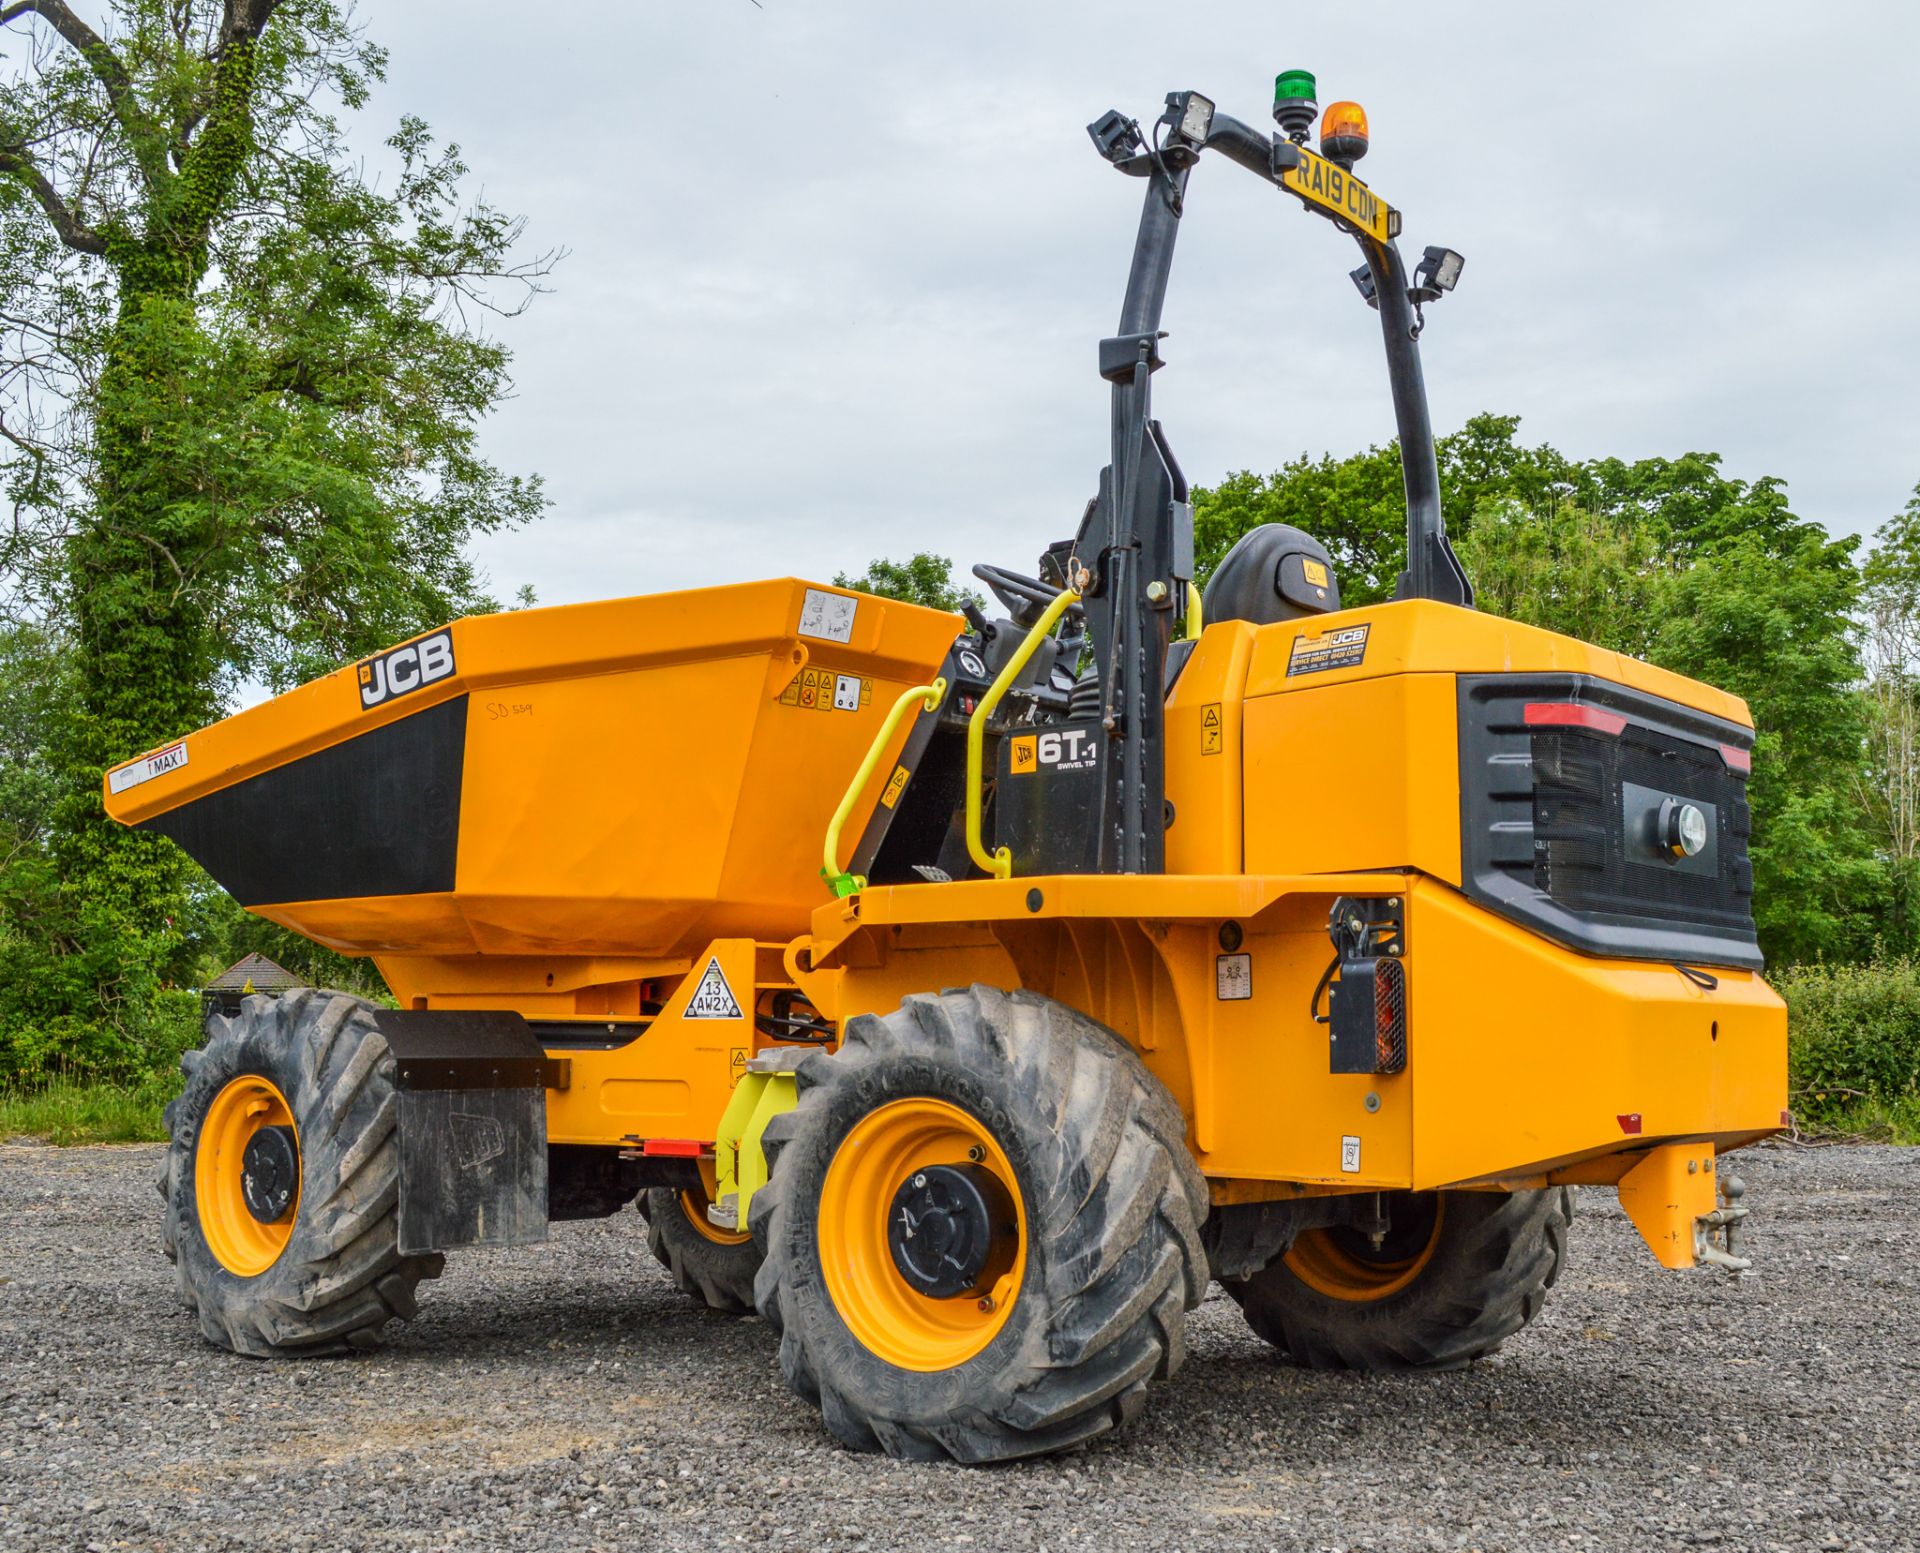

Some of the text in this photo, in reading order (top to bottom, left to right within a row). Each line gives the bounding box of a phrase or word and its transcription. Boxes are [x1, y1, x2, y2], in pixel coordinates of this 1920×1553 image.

[1298, 152, 1377, 230] RA19 CDN
[1333, 631, 1364, 644] JCB
[362, 634, 453, 705] JCB
[486, 702, 533, 720] SD 559
[154, 752, 178, 774] MAX
[1057, 760, 1096, 770] SWIVEL TIP
[705, 981, 721, 996] 13
[697, 997, 729, 1011] AW2X
